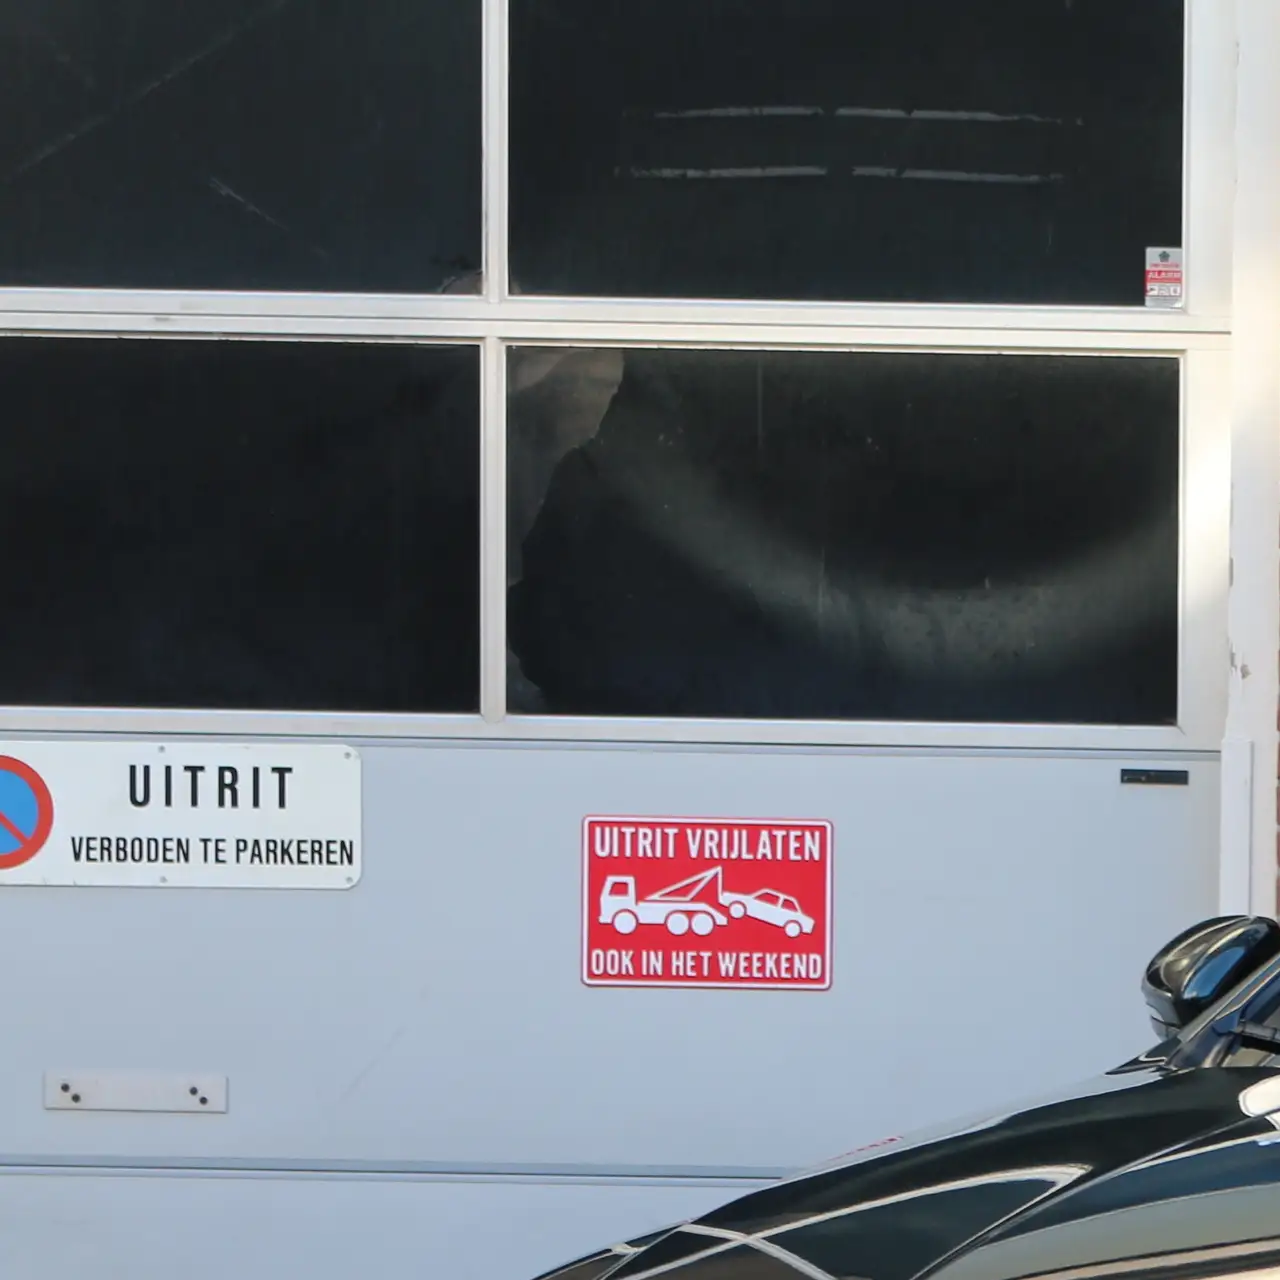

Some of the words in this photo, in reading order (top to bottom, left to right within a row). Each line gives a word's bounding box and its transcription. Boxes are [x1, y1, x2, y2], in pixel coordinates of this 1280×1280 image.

[129, 764, 293, 809] UITRIT
[71, 836, 191, 863] VERBODEN
[199, 838, 227, 864] TE
[235, 838, 354, 866] PARKEREN
[595, 826, 679, 859] UITRIT
[686, 828, 821, 862] VRIJLATEN
[591, 949, 635, 976] OOK
[641, 951, 664, 976] IN
[671, 951, 713, 977] HET
[718, 952, 823, 979] WEEKEND
